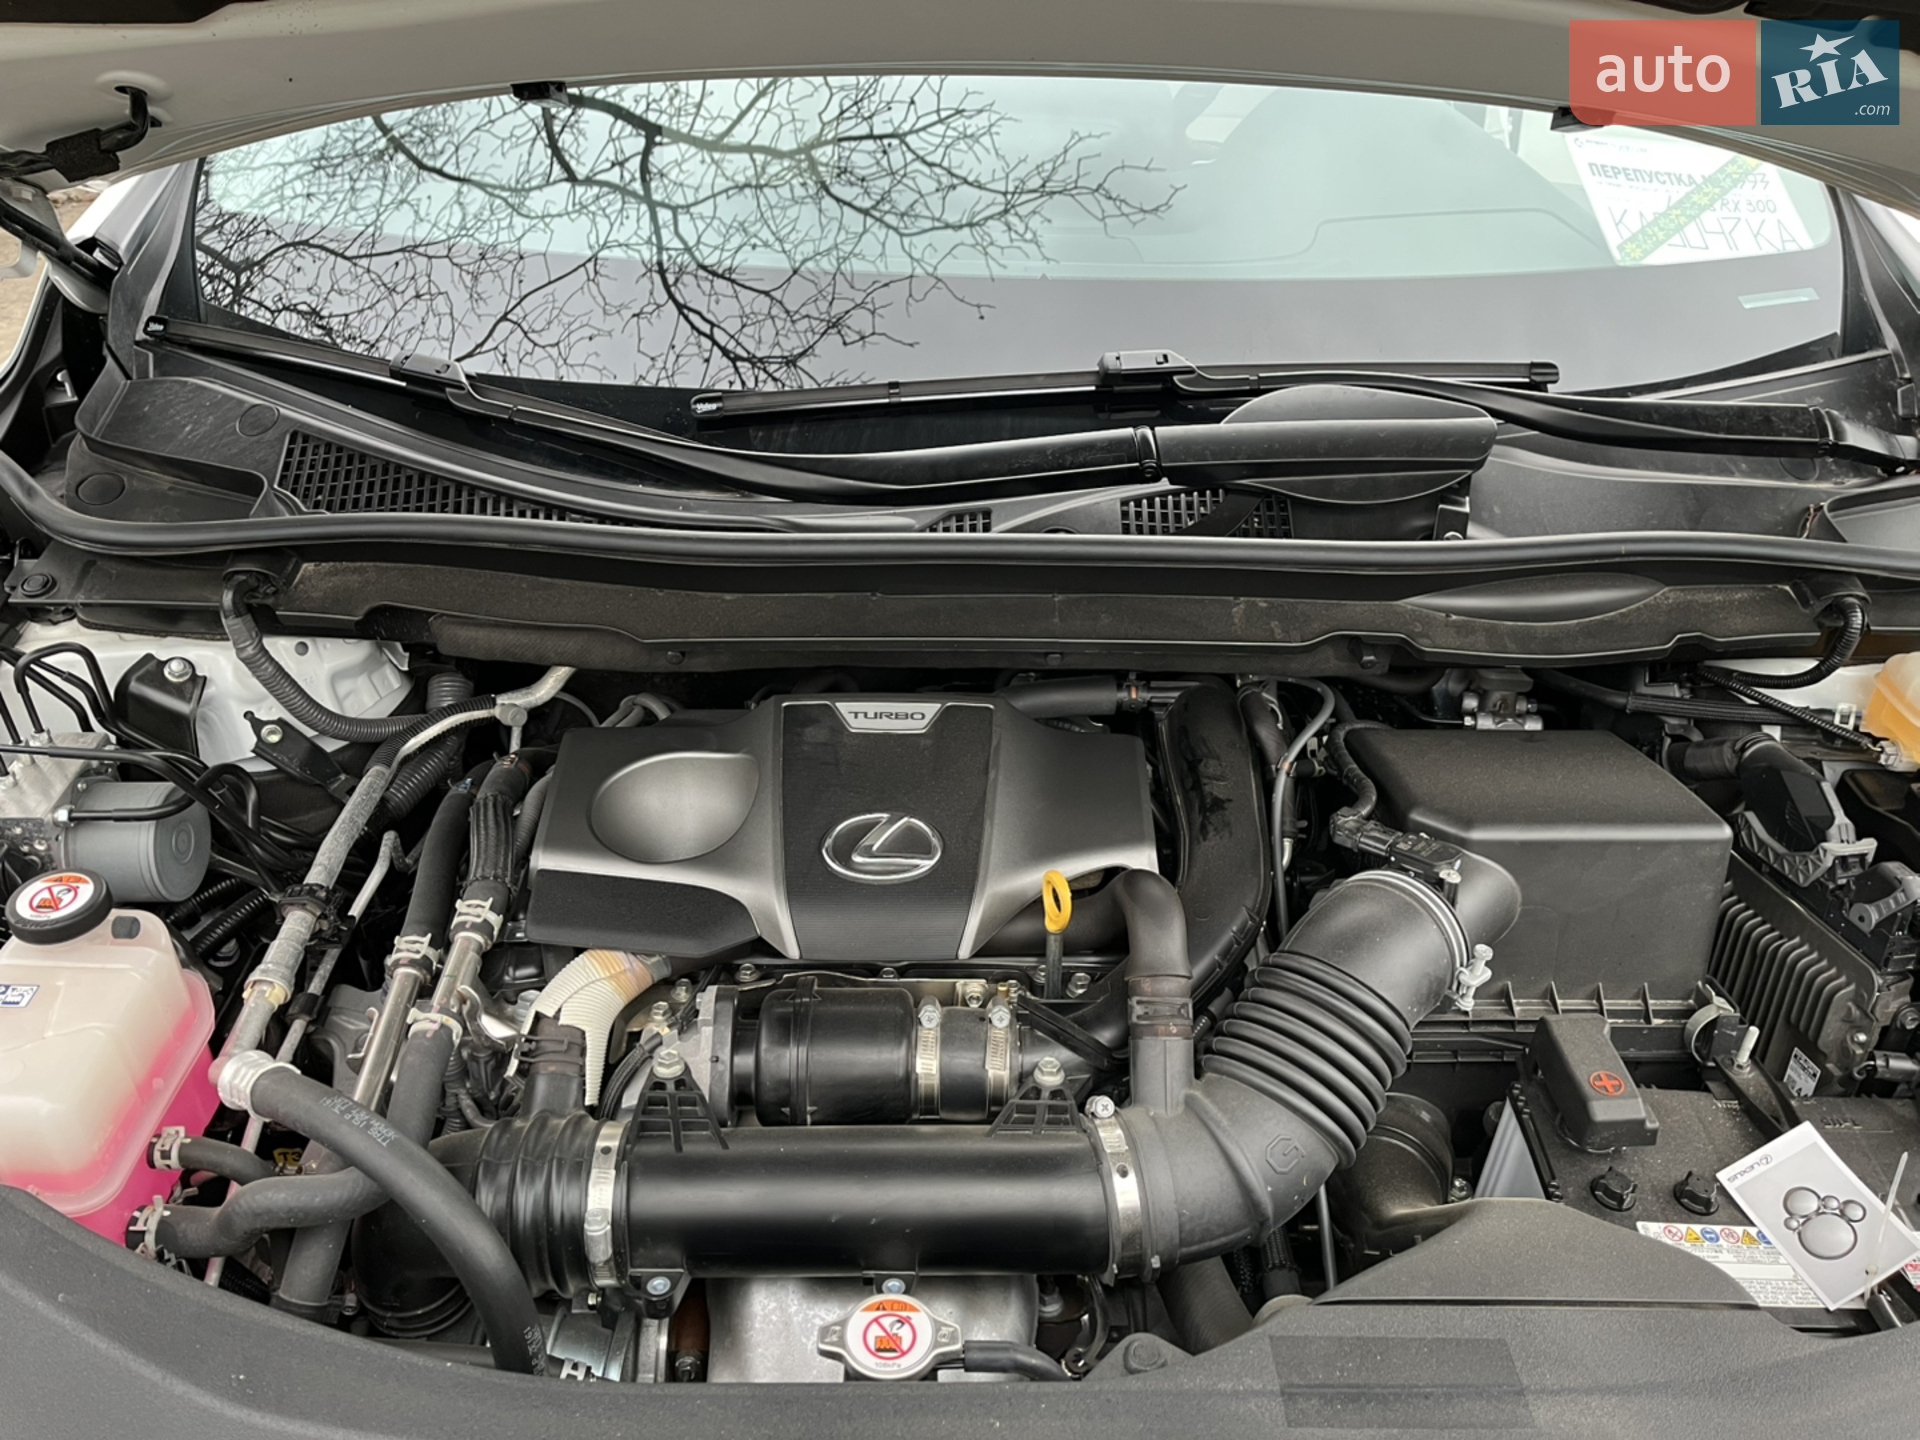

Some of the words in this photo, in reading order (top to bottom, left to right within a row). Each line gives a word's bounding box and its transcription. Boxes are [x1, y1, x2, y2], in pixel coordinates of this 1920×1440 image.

[1588, 162, 1700, 188] ПЕРЕПУСТКА
[1720, 198, 1741, 213] RX
[1746, 199, 1777, 214] 300
[848, 711, 926, 721] TURBO
[1264, 1133, 1307, 1175] G
[1727, 1161, 1763, 1184] LEXUS
